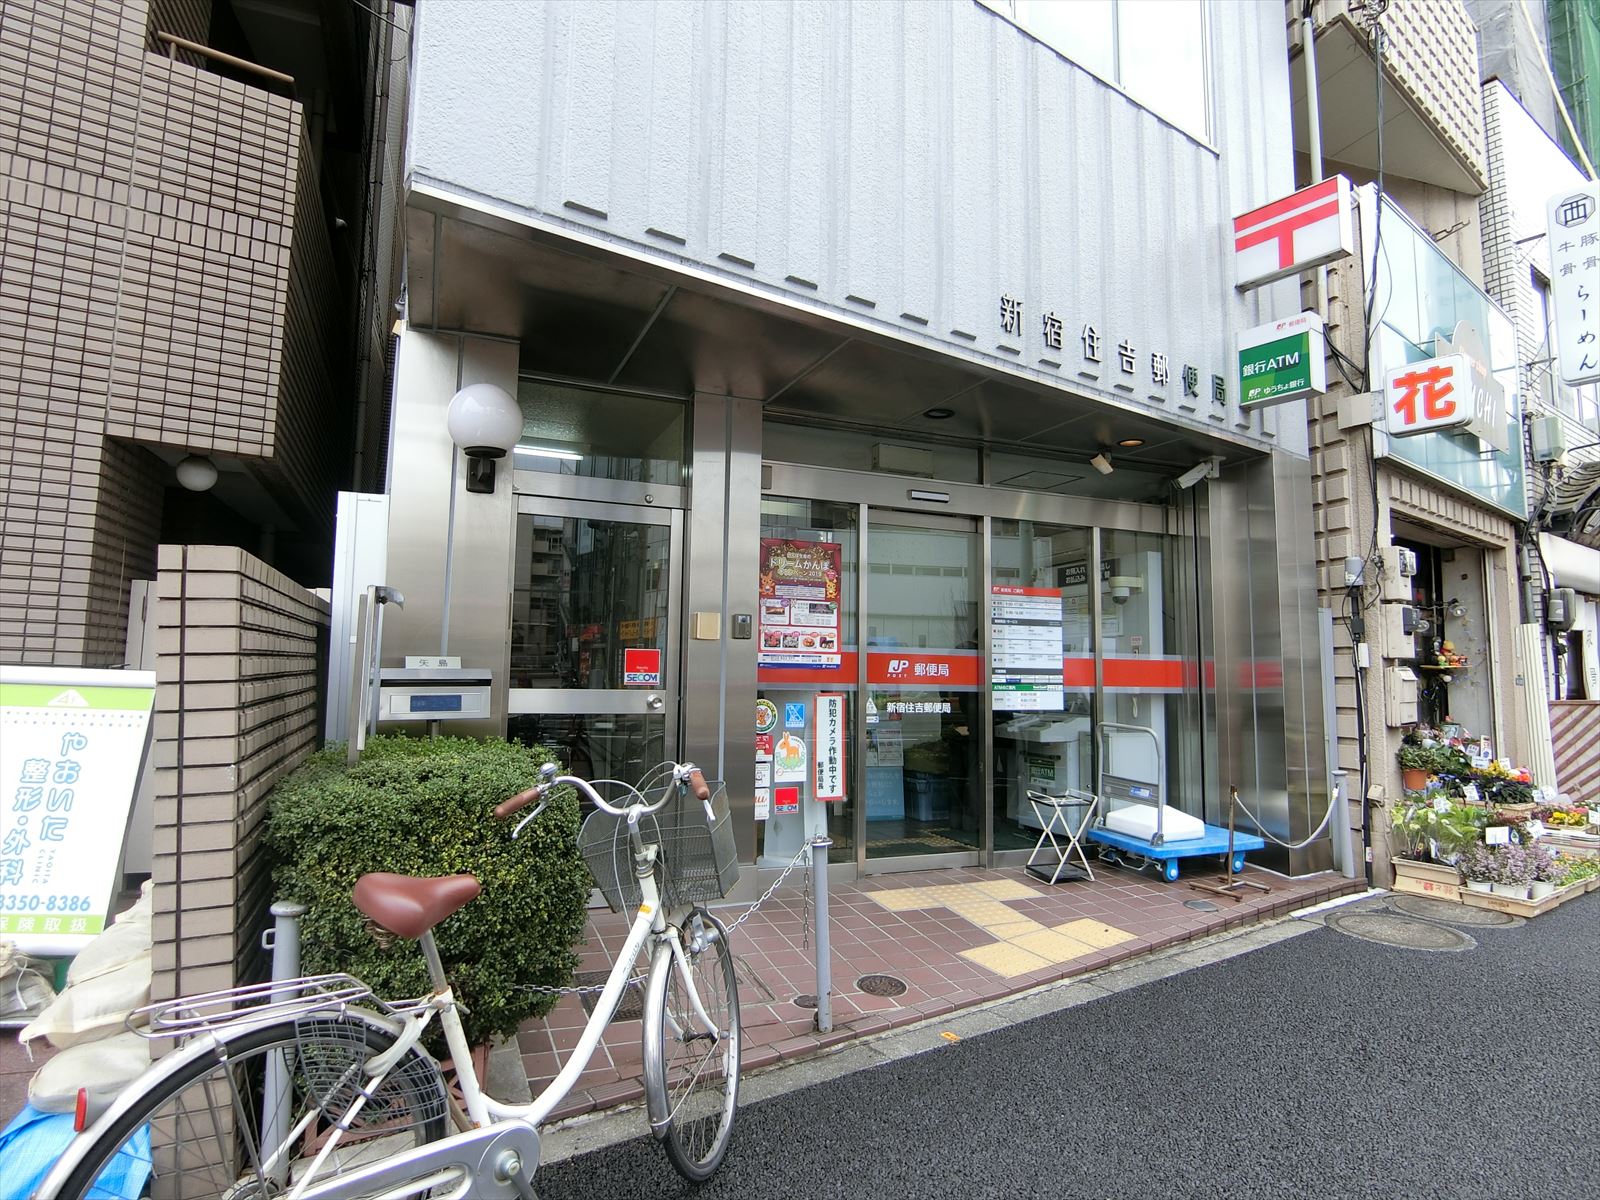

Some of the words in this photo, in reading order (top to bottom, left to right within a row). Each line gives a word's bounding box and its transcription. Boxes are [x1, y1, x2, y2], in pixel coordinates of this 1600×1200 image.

[1558, 240, 1577, 278] 牛骨
[1580, 231, 1600, 270] 豚骨
[1576, 285, 1598, 372] らーめん
[1001, 293, 1227, 406] 新宿住吉郵便局
[1242, 351, 1300, 377] 銀行ATM
[1263, 378, 1305, 395] ゆうちょ銀行
[1393, 365, 1457, 426] 花
[418, 659, 448, 668] 矢島
[626, 673, 658, 682] SECOM
[914, 663, 949, 677] 郵便局
[886, 702, 951, 714] 新宿住吉郵便局
[828, 698, 838, 795] 防犯カメラ作動中です
[39, 732, 88, 841] やおいた
[0, 758, 51, 886] 整形・外科
